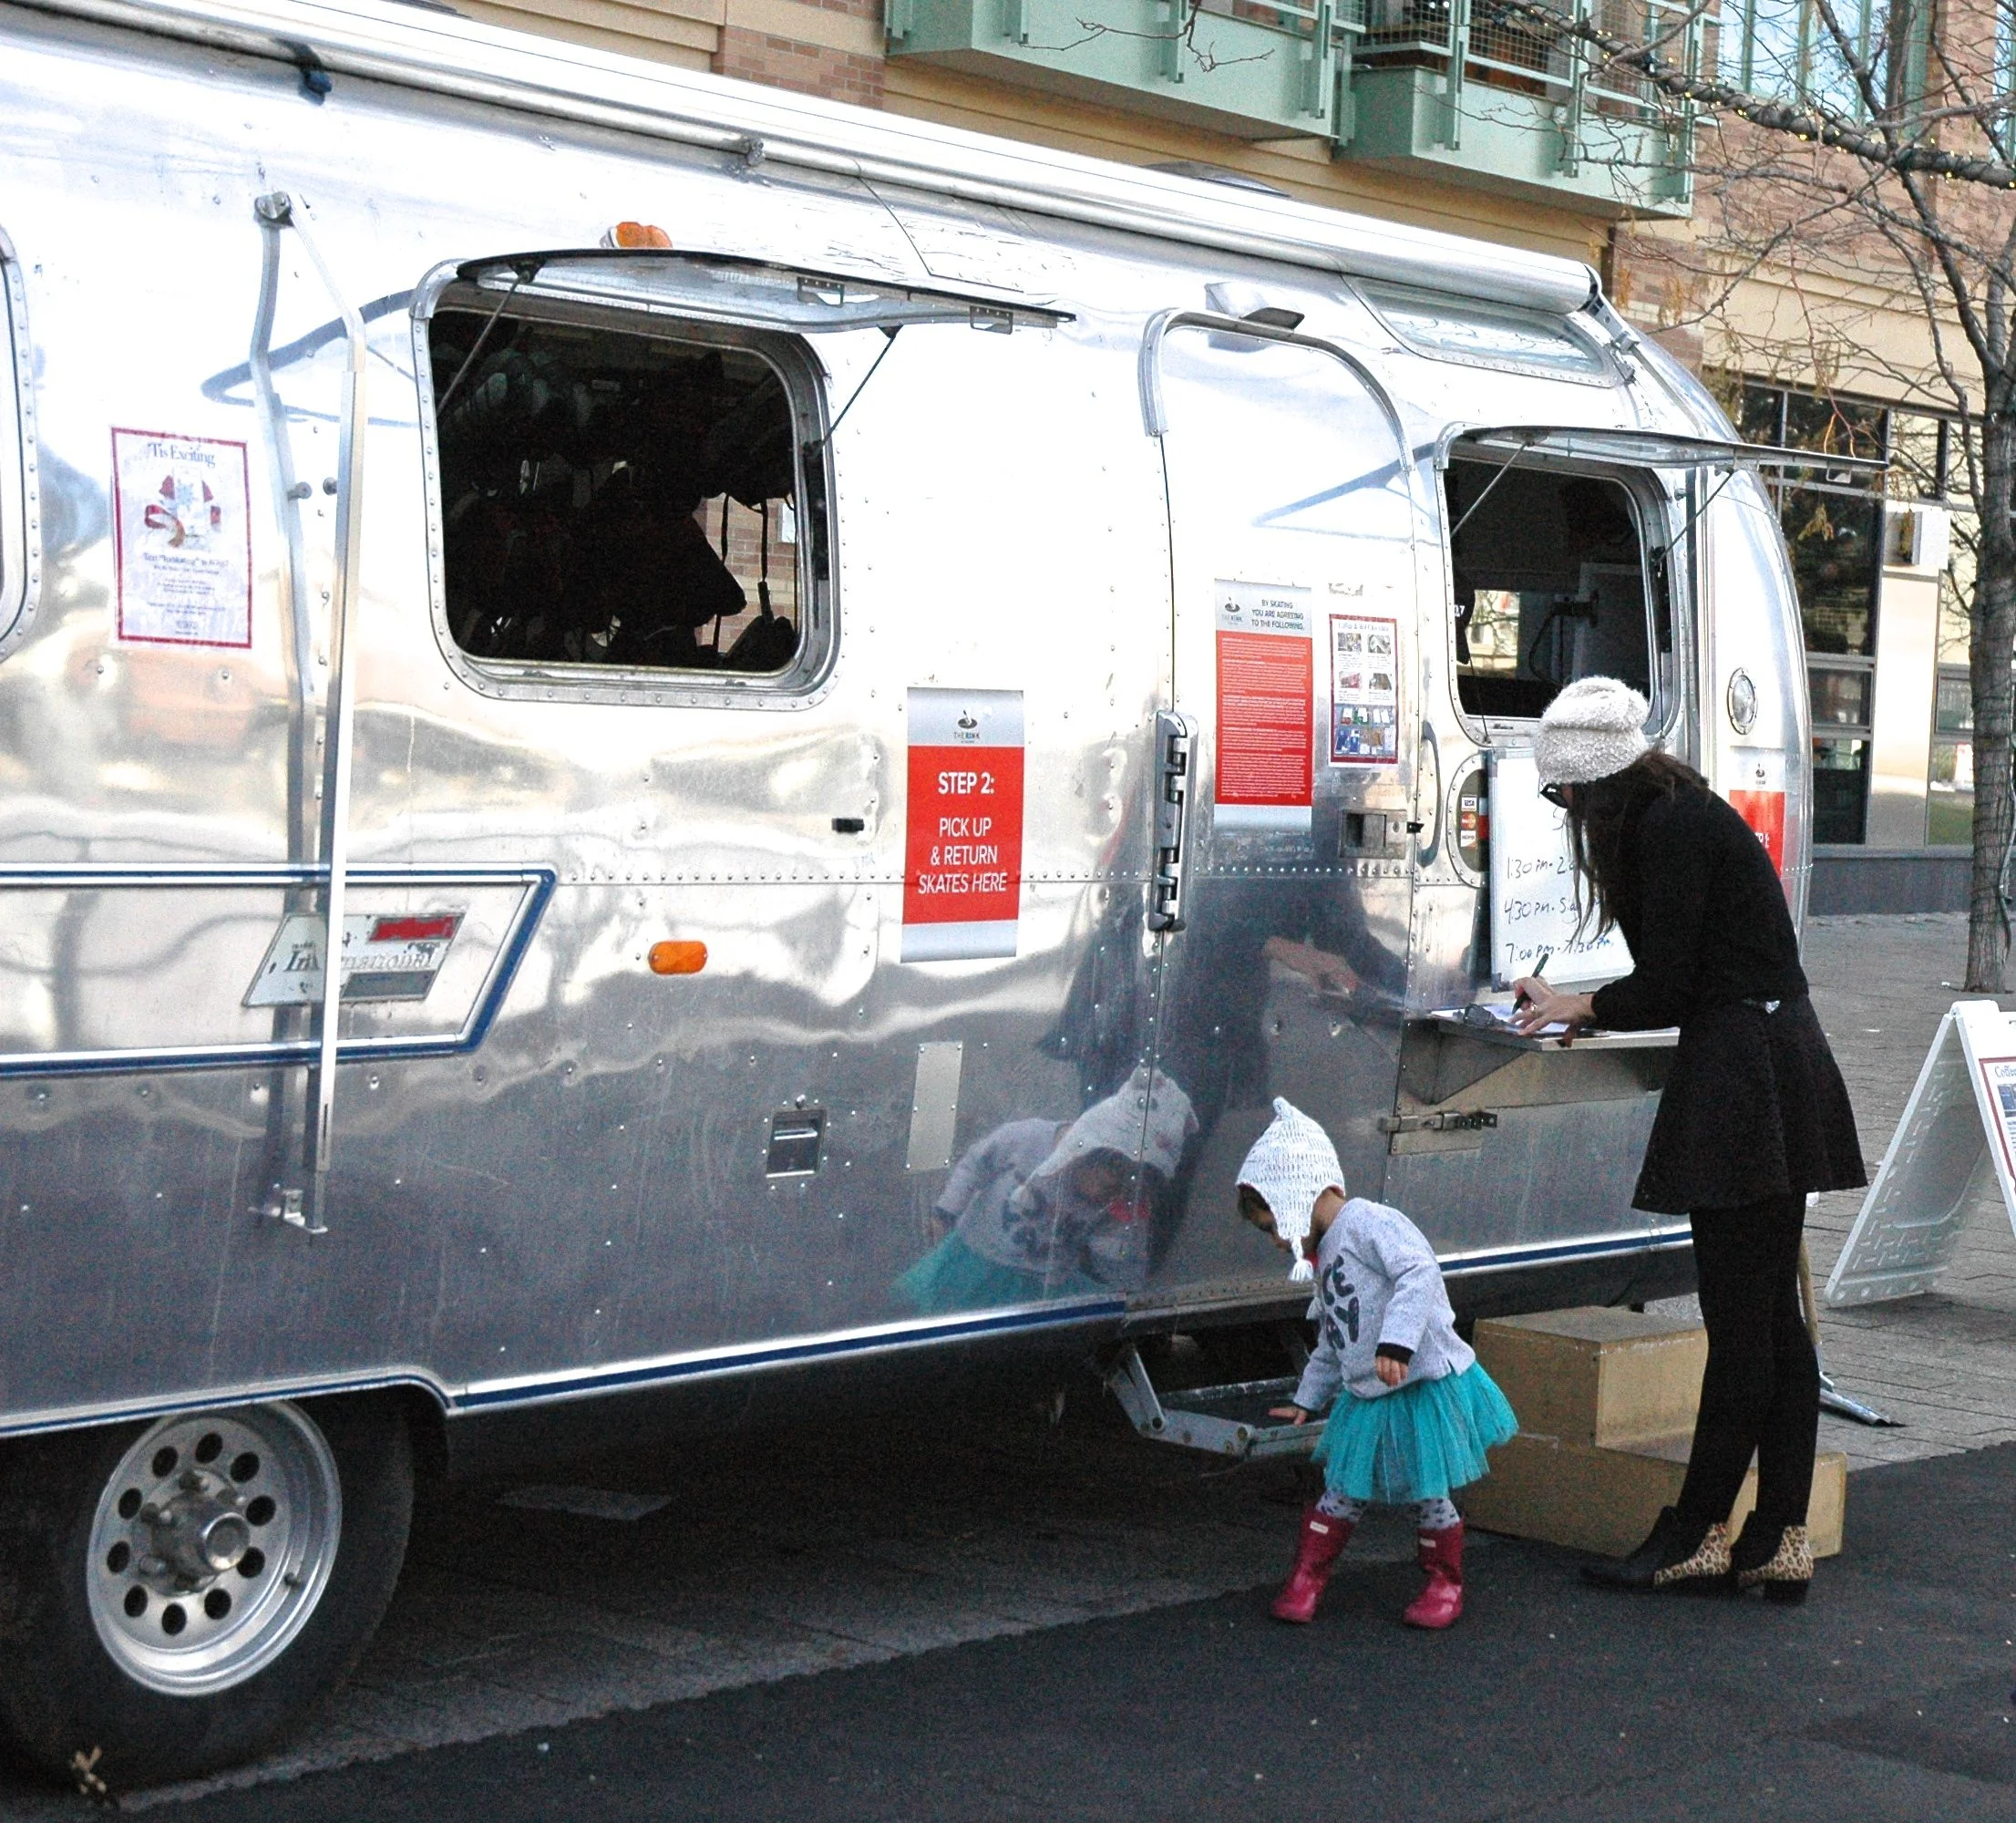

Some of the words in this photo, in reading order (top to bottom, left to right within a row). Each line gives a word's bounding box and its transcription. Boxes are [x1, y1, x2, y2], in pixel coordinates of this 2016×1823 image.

[1251, 609, 1264, 617] YOU
[1265, 610, 1275, 618] ARE
[1251, 619, 1259, 627] TO
[1260, 620, 1270, 628] THE
[938, 771, 977, 794] STEP
[981, 771, 994, 794] 2:
[939, 817, 969, 837] PICK
[972, 817, 992, 837] UP
[930, 845, 941, 866] &
[943, 845, 998, 866] RETURN
[918, 873, 969, 894] SKATES
[972, 871, 1007, 893] HERE
